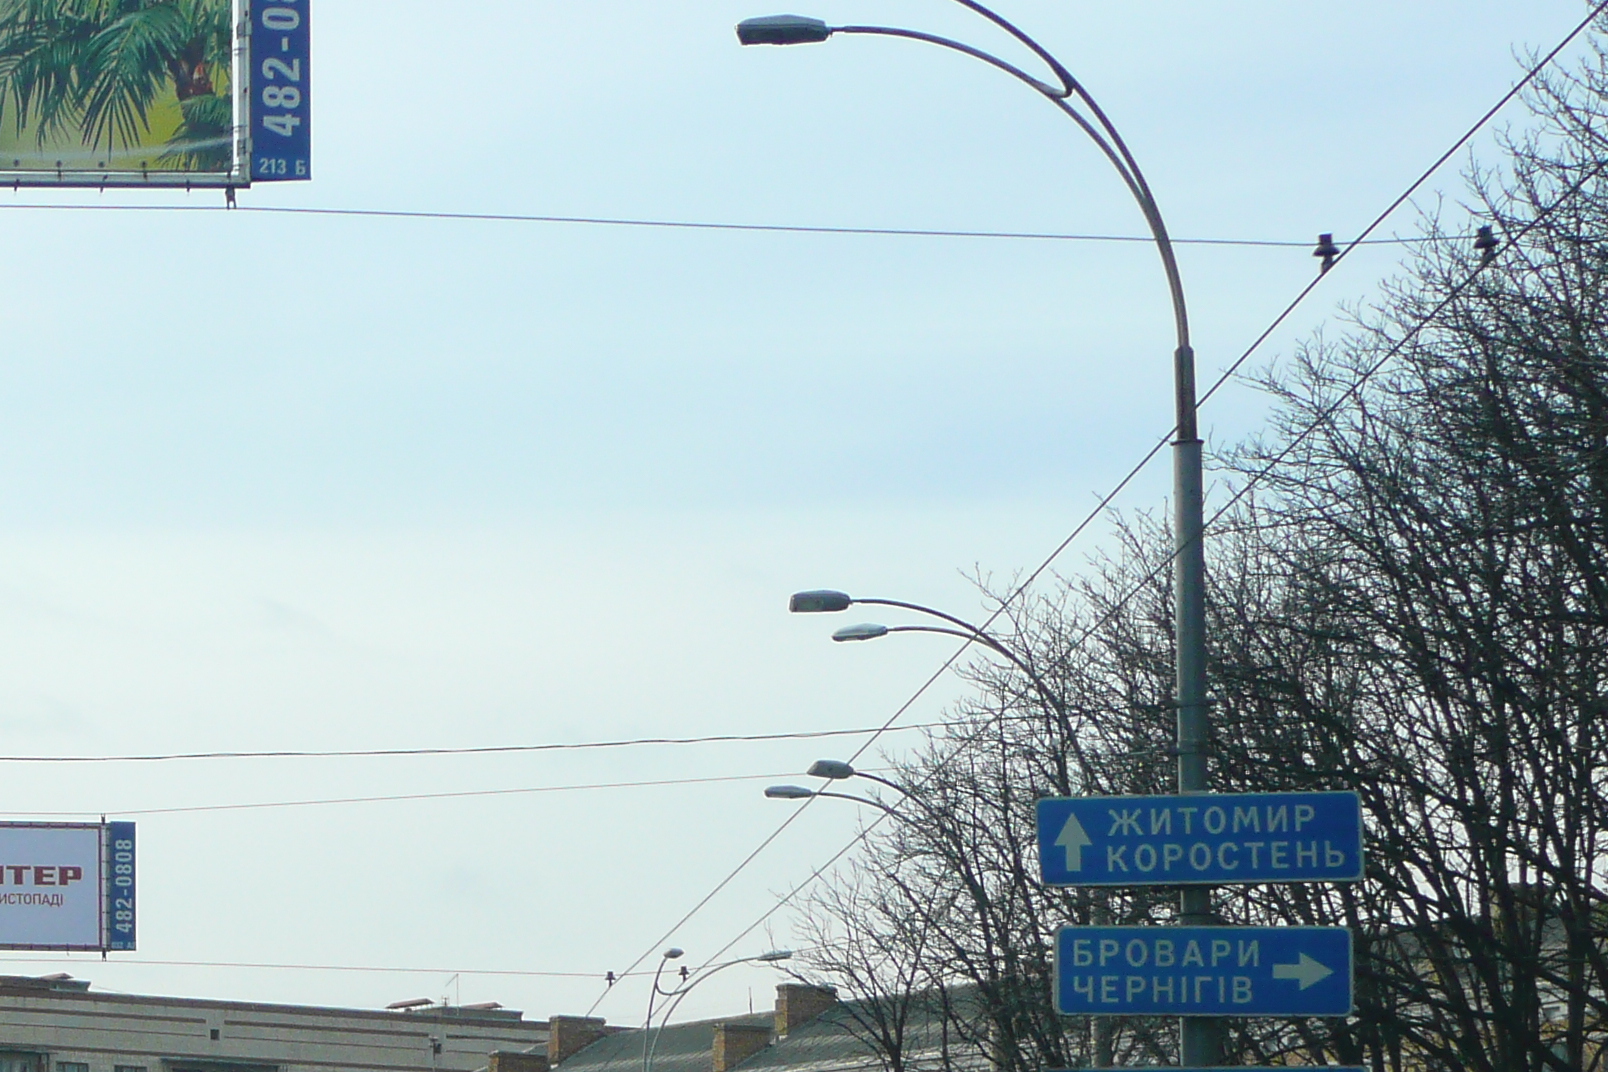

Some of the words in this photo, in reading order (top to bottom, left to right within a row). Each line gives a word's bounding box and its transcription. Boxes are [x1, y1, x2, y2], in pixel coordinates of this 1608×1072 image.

[262, 0, 301, 137] 482-0
[1107, 805, 1316, 837] ЖИТОМИР
[1107, 840, 1345, 873] КОРОСТЕНЬ
[115, 839, 133, 933] 482-0808
[1072, 939, 1260, 967] БРОВАРИ
[1073, 975, 1253, 1004] ЧЕРНІГІВ
